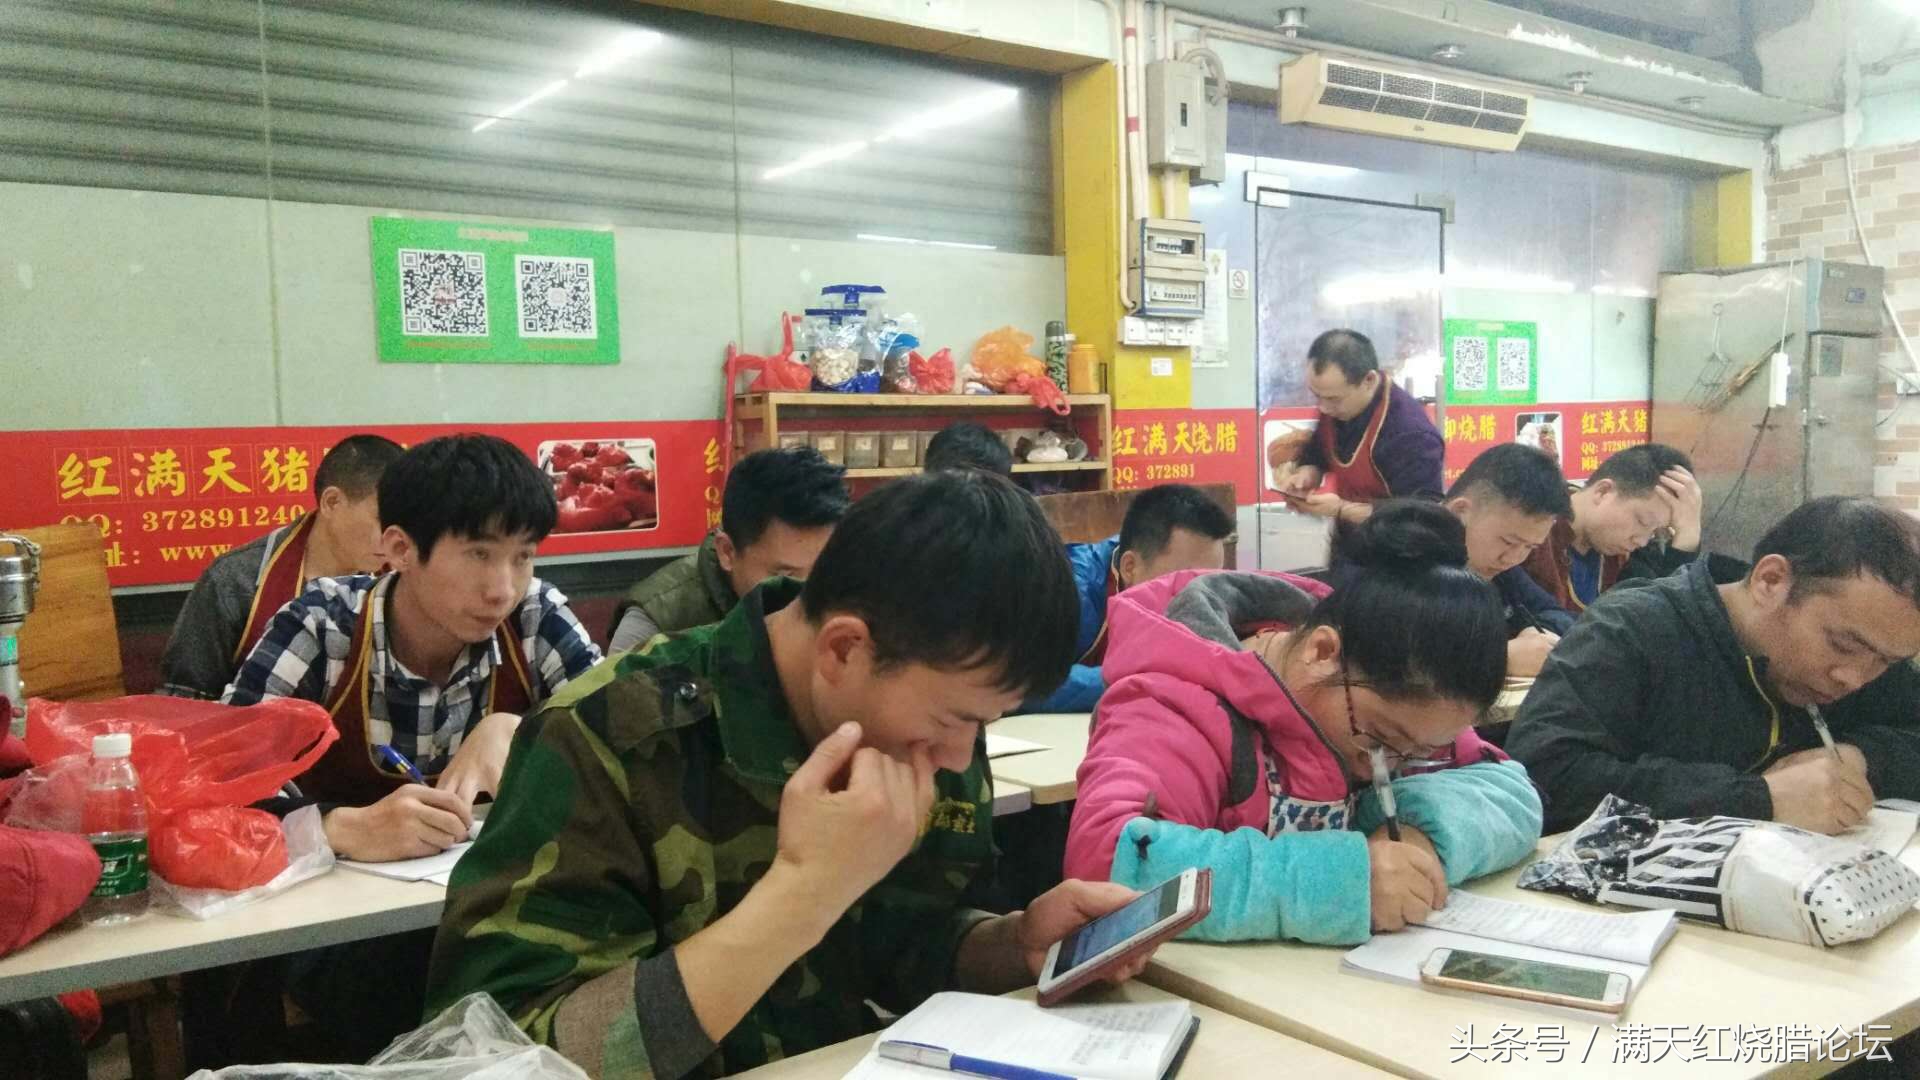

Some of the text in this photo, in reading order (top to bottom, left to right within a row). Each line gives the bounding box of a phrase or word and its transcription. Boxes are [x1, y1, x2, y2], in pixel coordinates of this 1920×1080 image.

[58, 447, 332, 499] 红满天猪
[1146, 463, 1195, 480] 372891
[142, 504, 306, 532] 372891240
